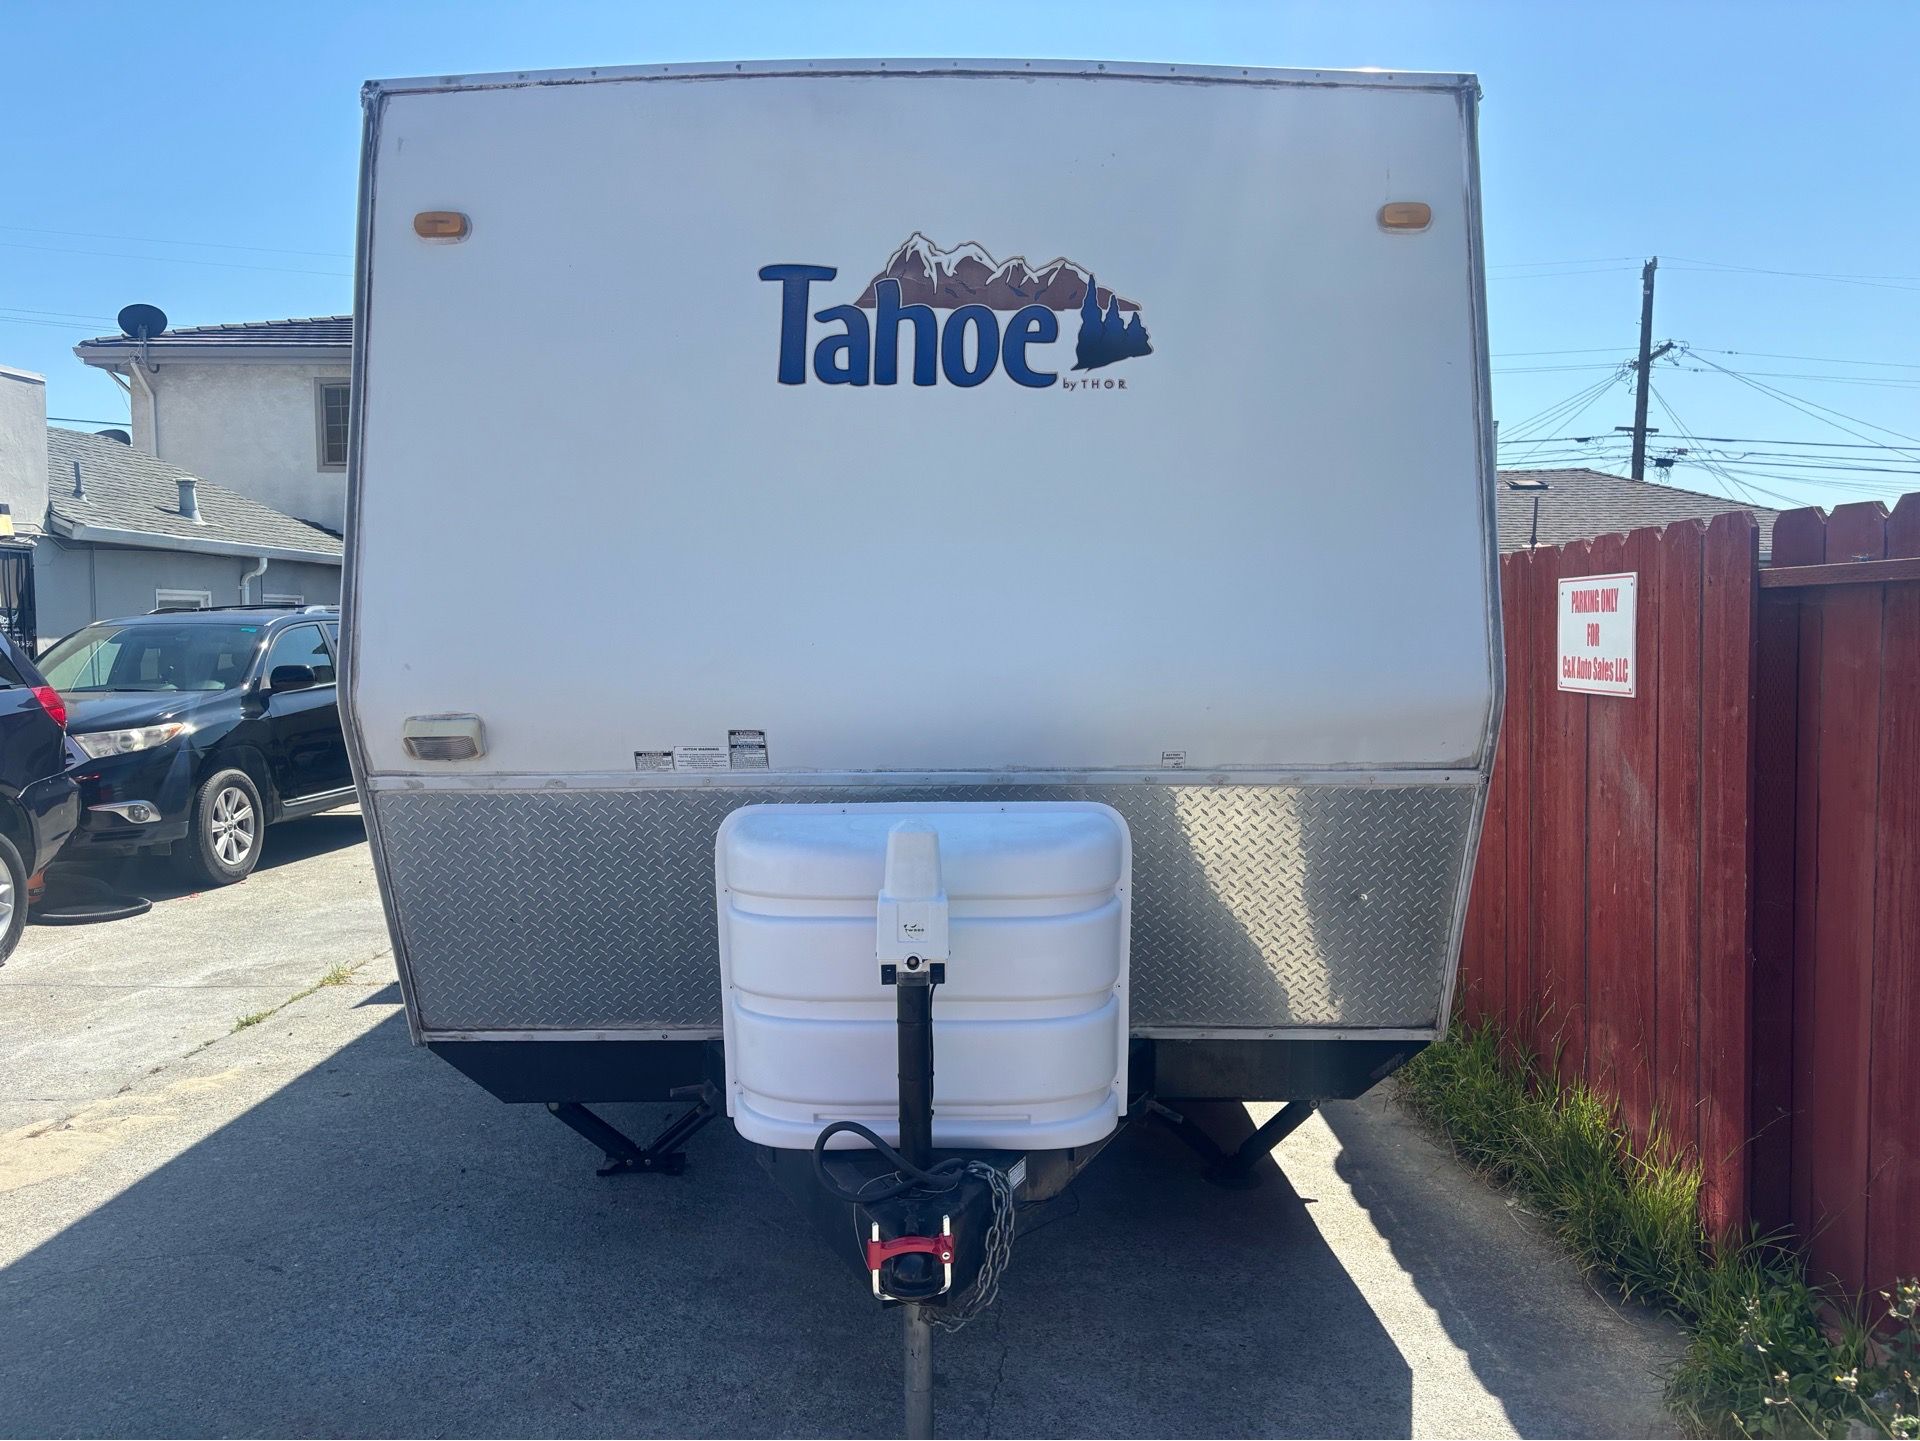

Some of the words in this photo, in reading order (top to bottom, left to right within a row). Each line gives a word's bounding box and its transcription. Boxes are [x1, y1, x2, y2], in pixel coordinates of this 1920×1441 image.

[758, 263, 1059, 388] Tahoe
[1063, 378, 1077, 392] by
[1081, 379, 1127, 389] THOR
[1571, 589, 1600, 614] PARKING
[1601, 587, 1619, 613] ONLY
[1586, 623, 1600, 648] FOR
[1562, 655, 1576, 679] C&K
[1577, 656, 1592, 680] Auto
[1593, 656, 1614, 682] Sales
[1615, 657, 1629, 683] LLC
